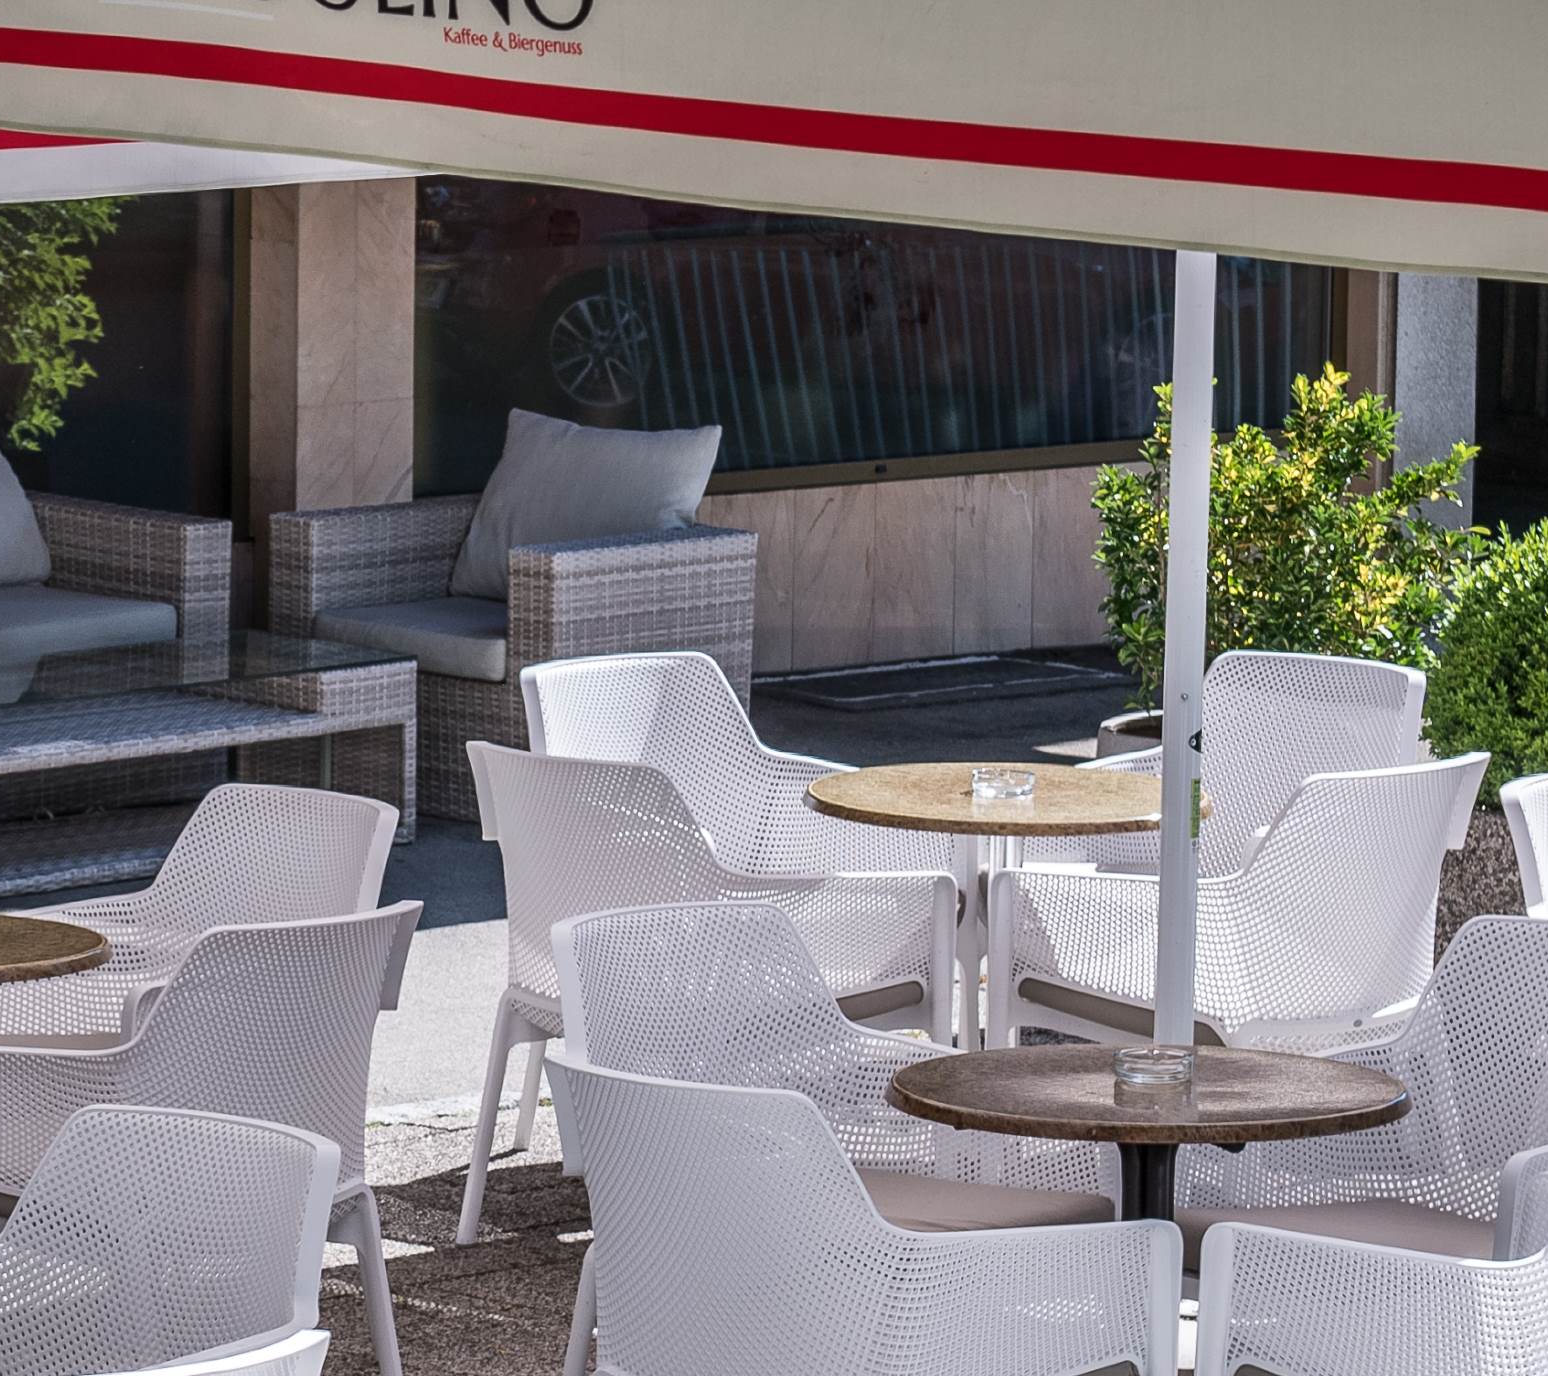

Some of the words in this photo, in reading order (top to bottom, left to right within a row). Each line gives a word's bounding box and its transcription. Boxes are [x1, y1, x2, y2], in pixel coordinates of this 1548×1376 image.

[443, 27, 488, 47] Kaffee
[492, 31, 508, 52] &
[508, 32, 584, 57] Biergenuss
